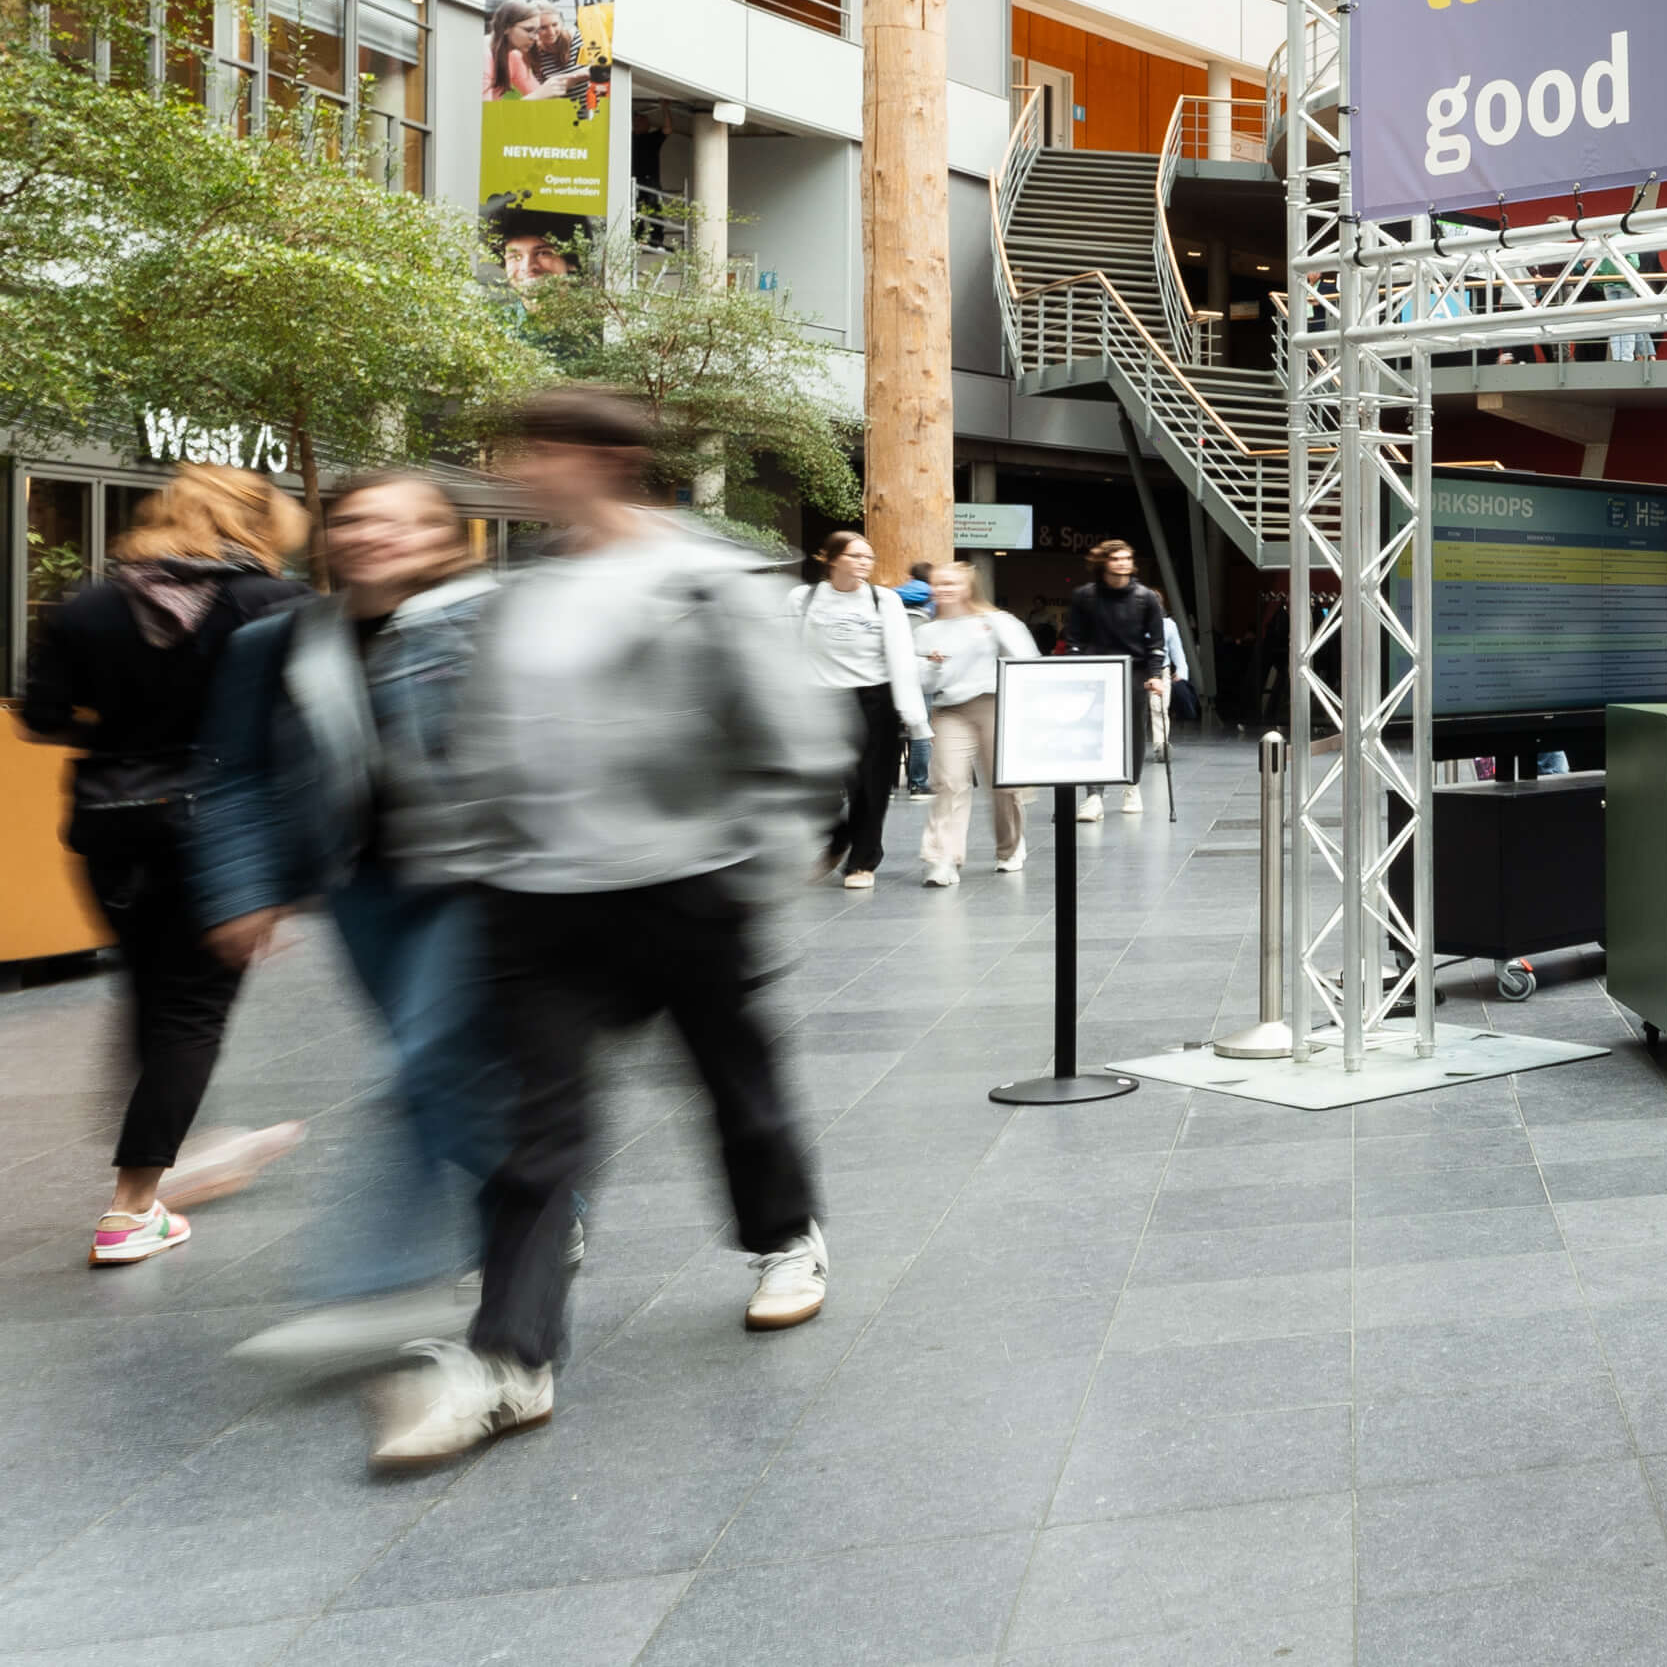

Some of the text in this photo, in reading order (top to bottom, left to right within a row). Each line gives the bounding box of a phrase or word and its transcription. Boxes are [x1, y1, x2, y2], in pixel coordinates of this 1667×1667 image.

[1425, 30, 1630, 176] good
[503, 145, 588, 160] NETWERKEN
[145, 401, 244, 468] West
[1402, 491, 1535, 518] RKSHOPS
[1059, 525, 1112, 553] Spor
